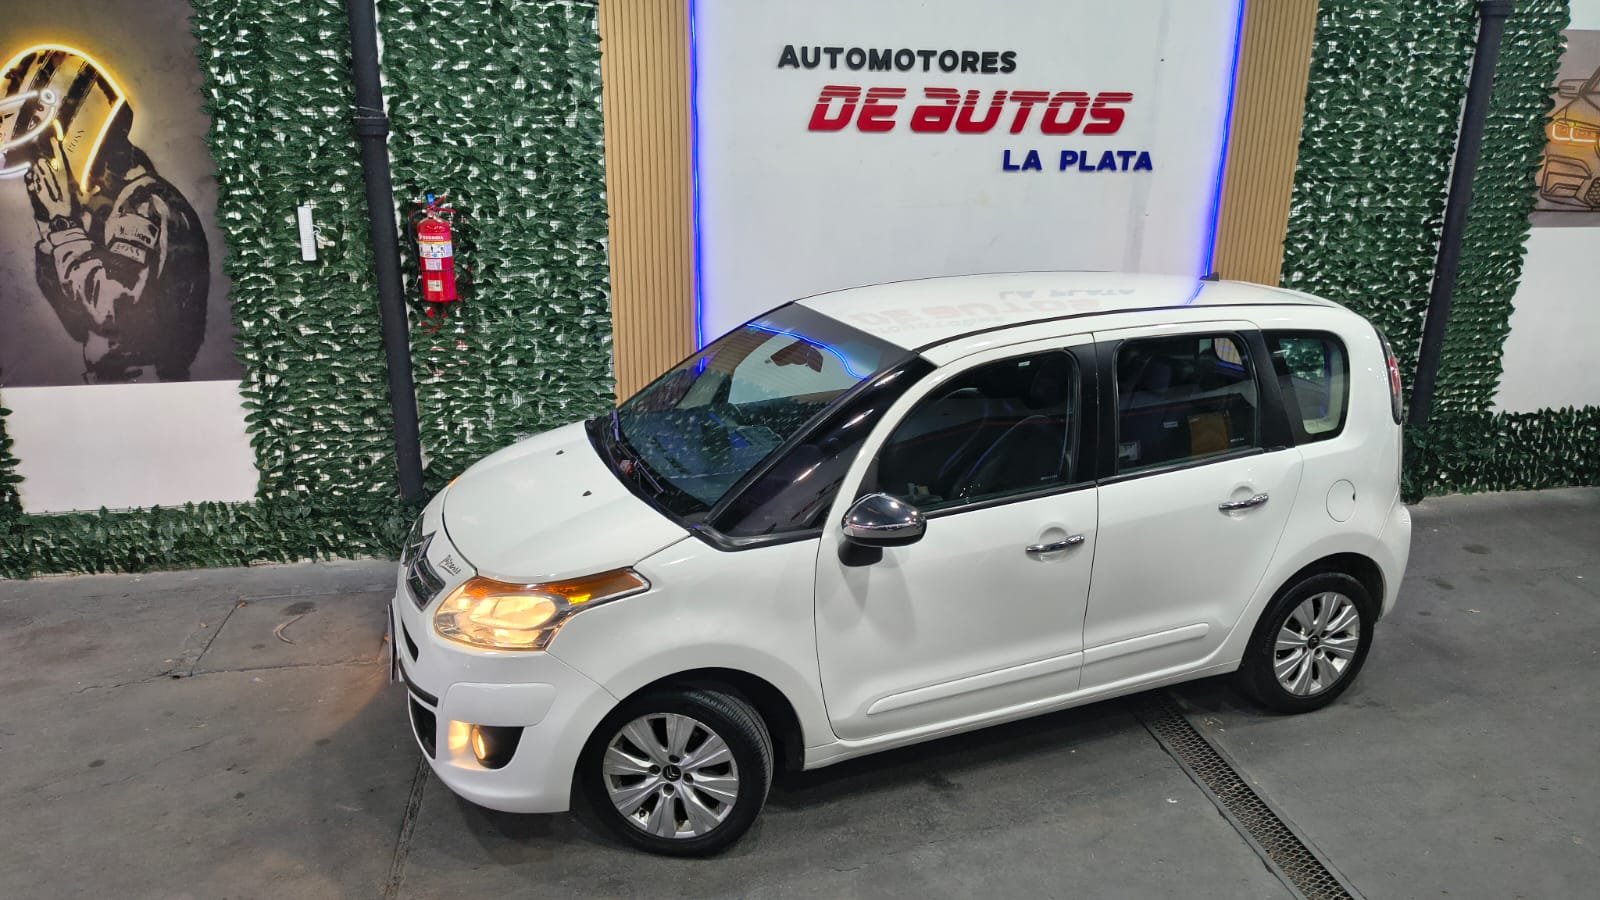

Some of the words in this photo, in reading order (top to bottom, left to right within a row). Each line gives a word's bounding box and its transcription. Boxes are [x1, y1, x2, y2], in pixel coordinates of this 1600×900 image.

[778, 44, 1017, 74] AUTOMOTORES
[808, 85, 906, 133] DE
[1002, 149, 1042, 171] LA
[1059, 150, 1153, 171] PLATA
